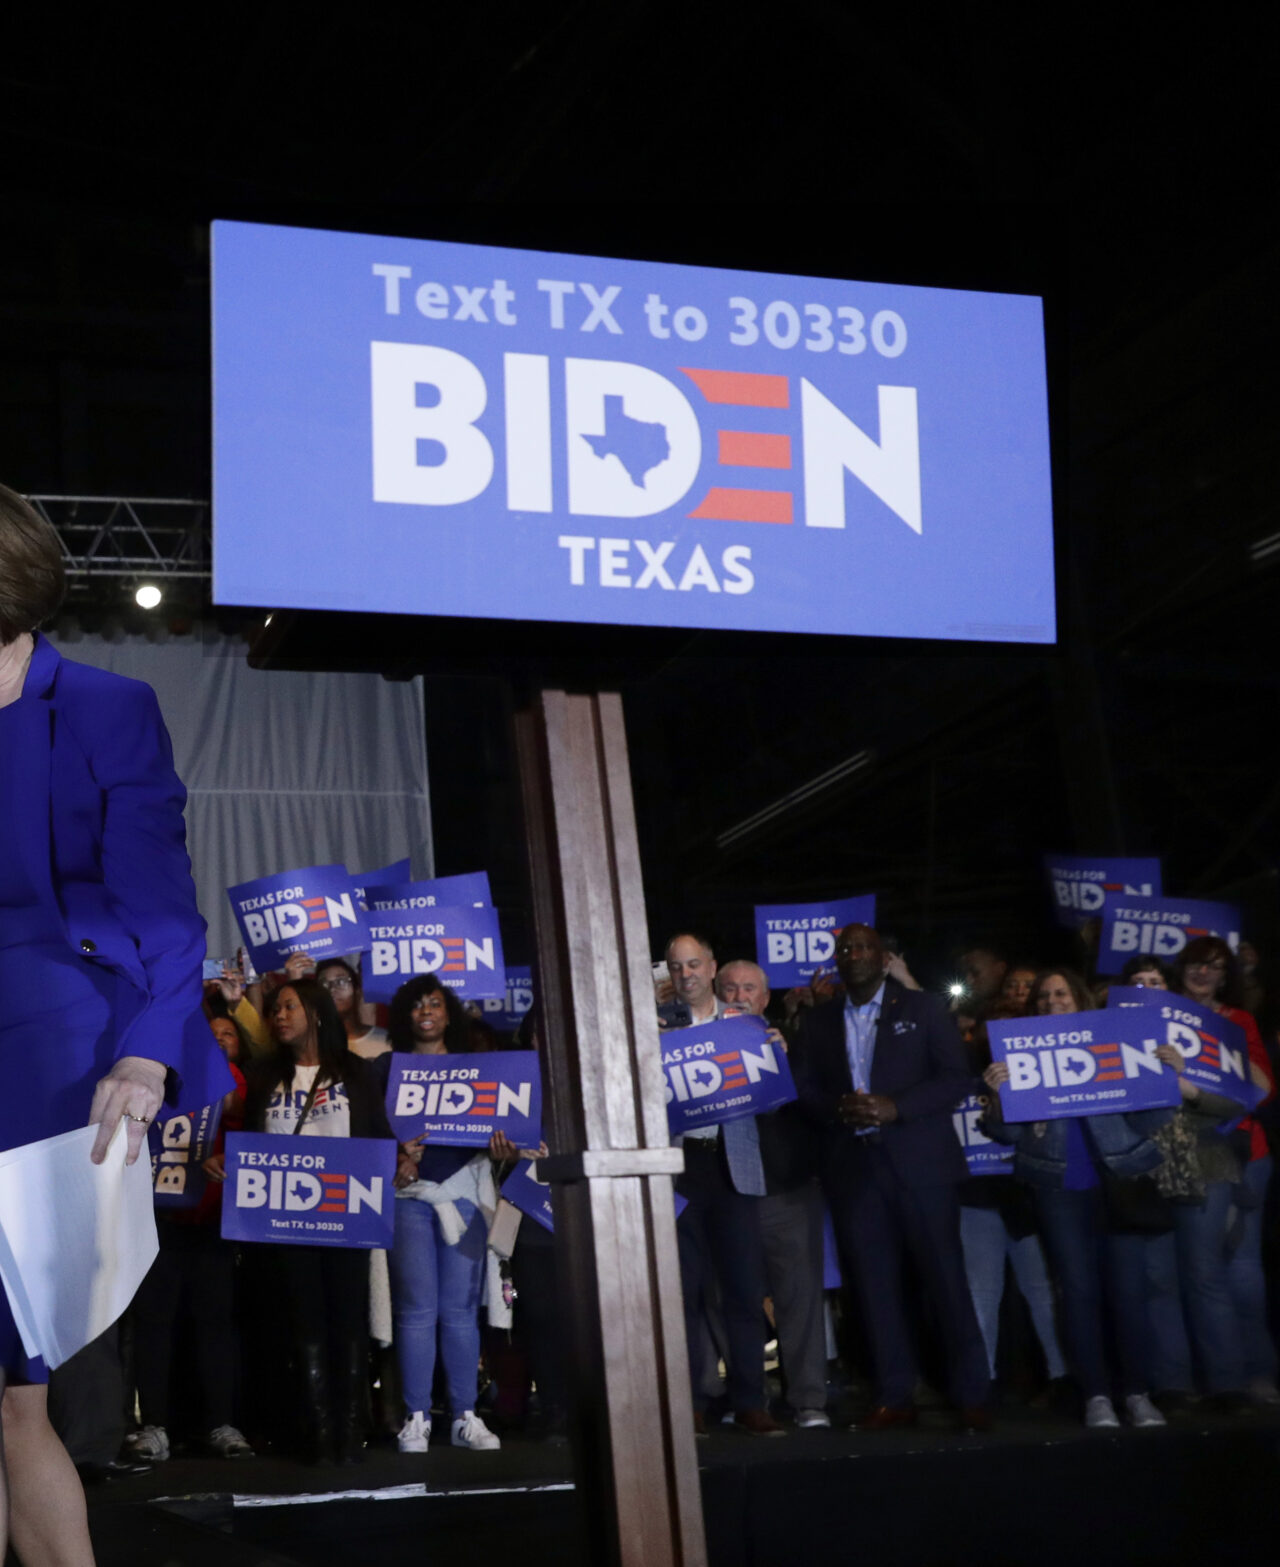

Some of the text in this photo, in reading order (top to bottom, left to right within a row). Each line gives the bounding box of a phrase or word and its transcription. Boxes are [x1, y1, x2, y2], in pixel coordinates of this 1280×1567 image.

[372, 263, 908, 358] Text TX to 30330
[371, 340, 922, 535] BIDEN
[559, 535, 756, 595] TEXAS
[1082, 870, 1106, 880] FOR
[240, 886, 304, 912] TEXAS FOR
[374, 899, 408, 911] TEXAS
[410, 896, 436, 908] FOR
[243, 893, 357, 947] BIDEN
[766, 916, 836, 930] TEXAS FOR
[1115, 908, 1191, 924] TEXAS FOR
[370, 924, 445, 938] TEXAS FOR
[1110, 921, 1240, 956] BID
[371, 937, 495, 976] BIDEN
[767, 929, 839, 964] BID
[483, 988, 534, 1013] BID
[1174, 1009, 1202, 1028] FOR
[684, 1041, 716, 1059] FOR
[1002, 1030, 1093, 1050] TEXAS FOR
[1167, 1021, 1245, 1082] DEN
[401, 1068, 479, 1081] TEXAS FOR
[1006, 1038, 1163, 1091] BIDEN
[395, 1082, 531, 1118] BIDEN
[1071, 1093, 1084, 1102] TX
[1085, 1091, 1096, 1101] to
[266, 1103, 349, 1119] RESDEN
[703, 1104, 715, 1112] TX
[424, 1123, 441, 1131] Text
[443, 1123, 455, 1131] TX
[466, 1124, 493, 1133] 30330
[155, 1112, 194, 1194] BID
[238, 1152, 325, 1169] TEXAS FOR
[236, 1168, 383, 1215] BIDEN
[271, 1219, 344, 1231] Text TX to 30330
